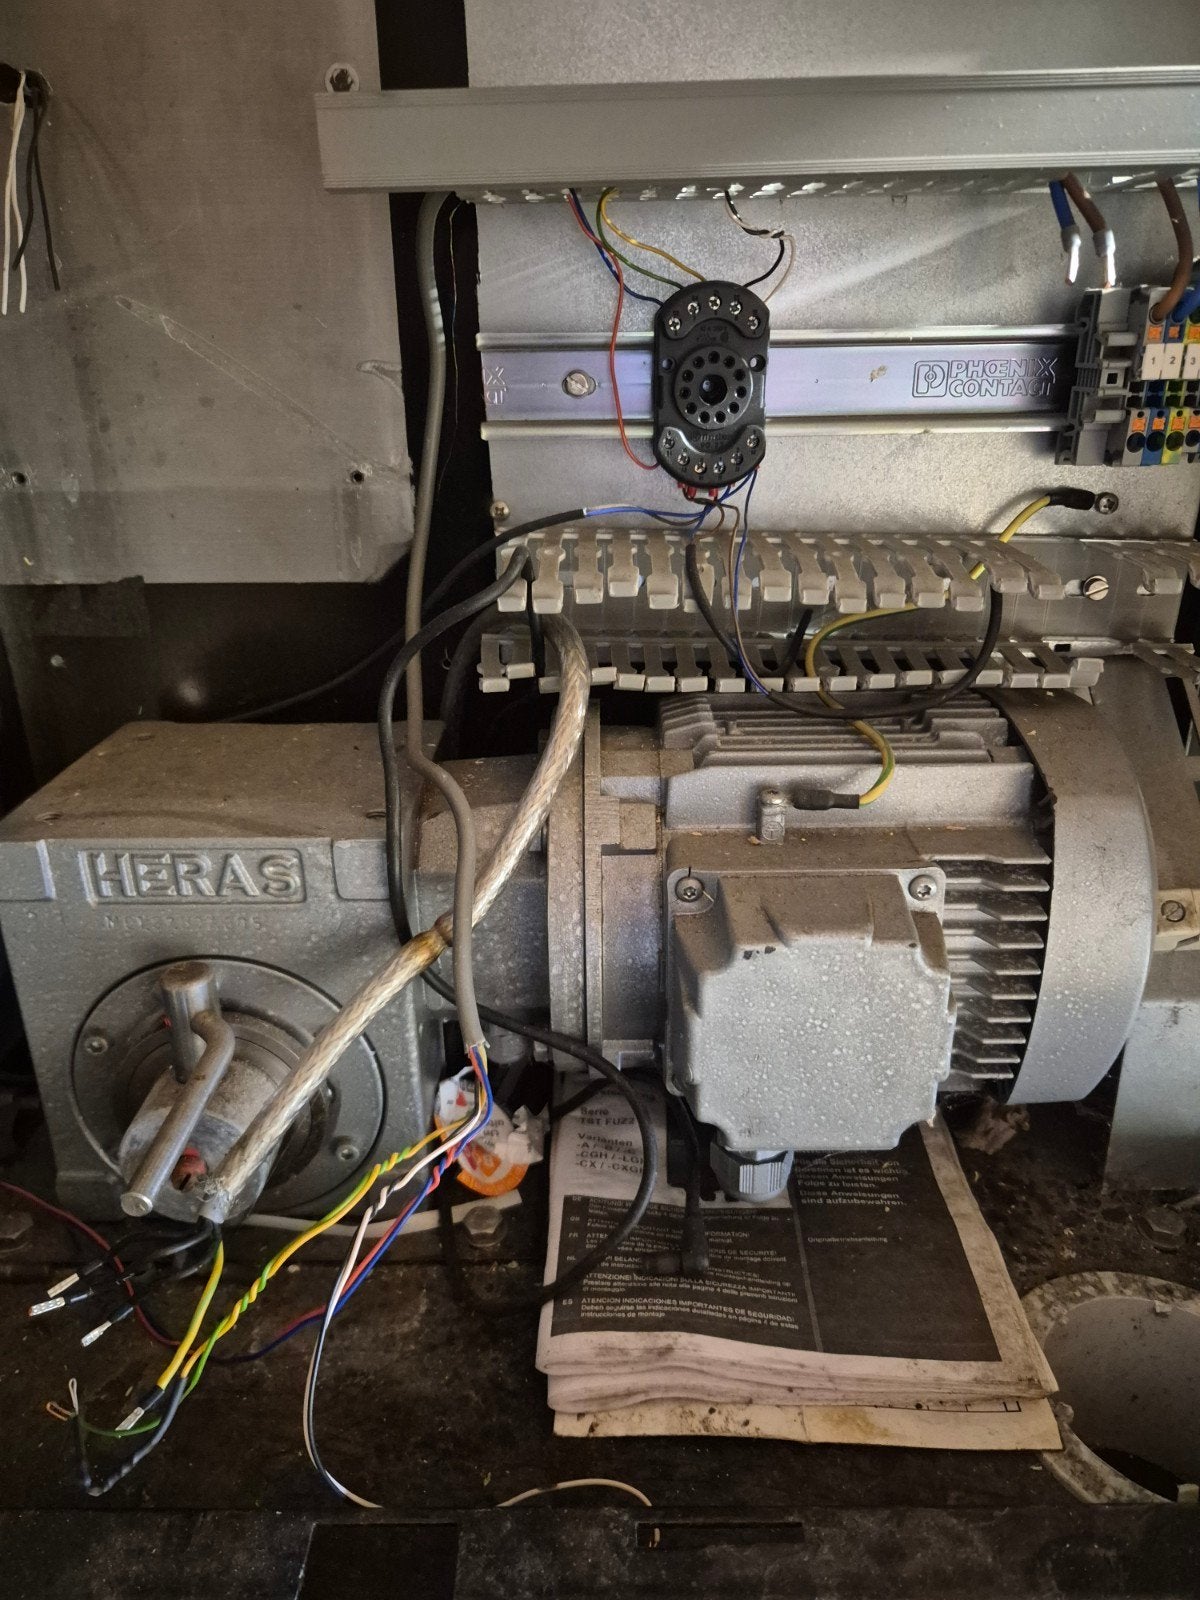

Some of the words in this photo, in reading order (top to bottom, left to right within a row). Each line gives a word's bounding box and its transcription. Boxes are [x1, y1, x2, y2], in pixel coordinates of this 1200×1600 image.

[1151, 356, 1156, 365] 1
[1169, 356, 1177, 365] 2
[1190, 356, 1196, 365] 3
[97, 852, 302, 897] HERAS
[577, 1132, 633, 1147] Varianten
[622, 1297, 678, 1306] INDICACIONES
